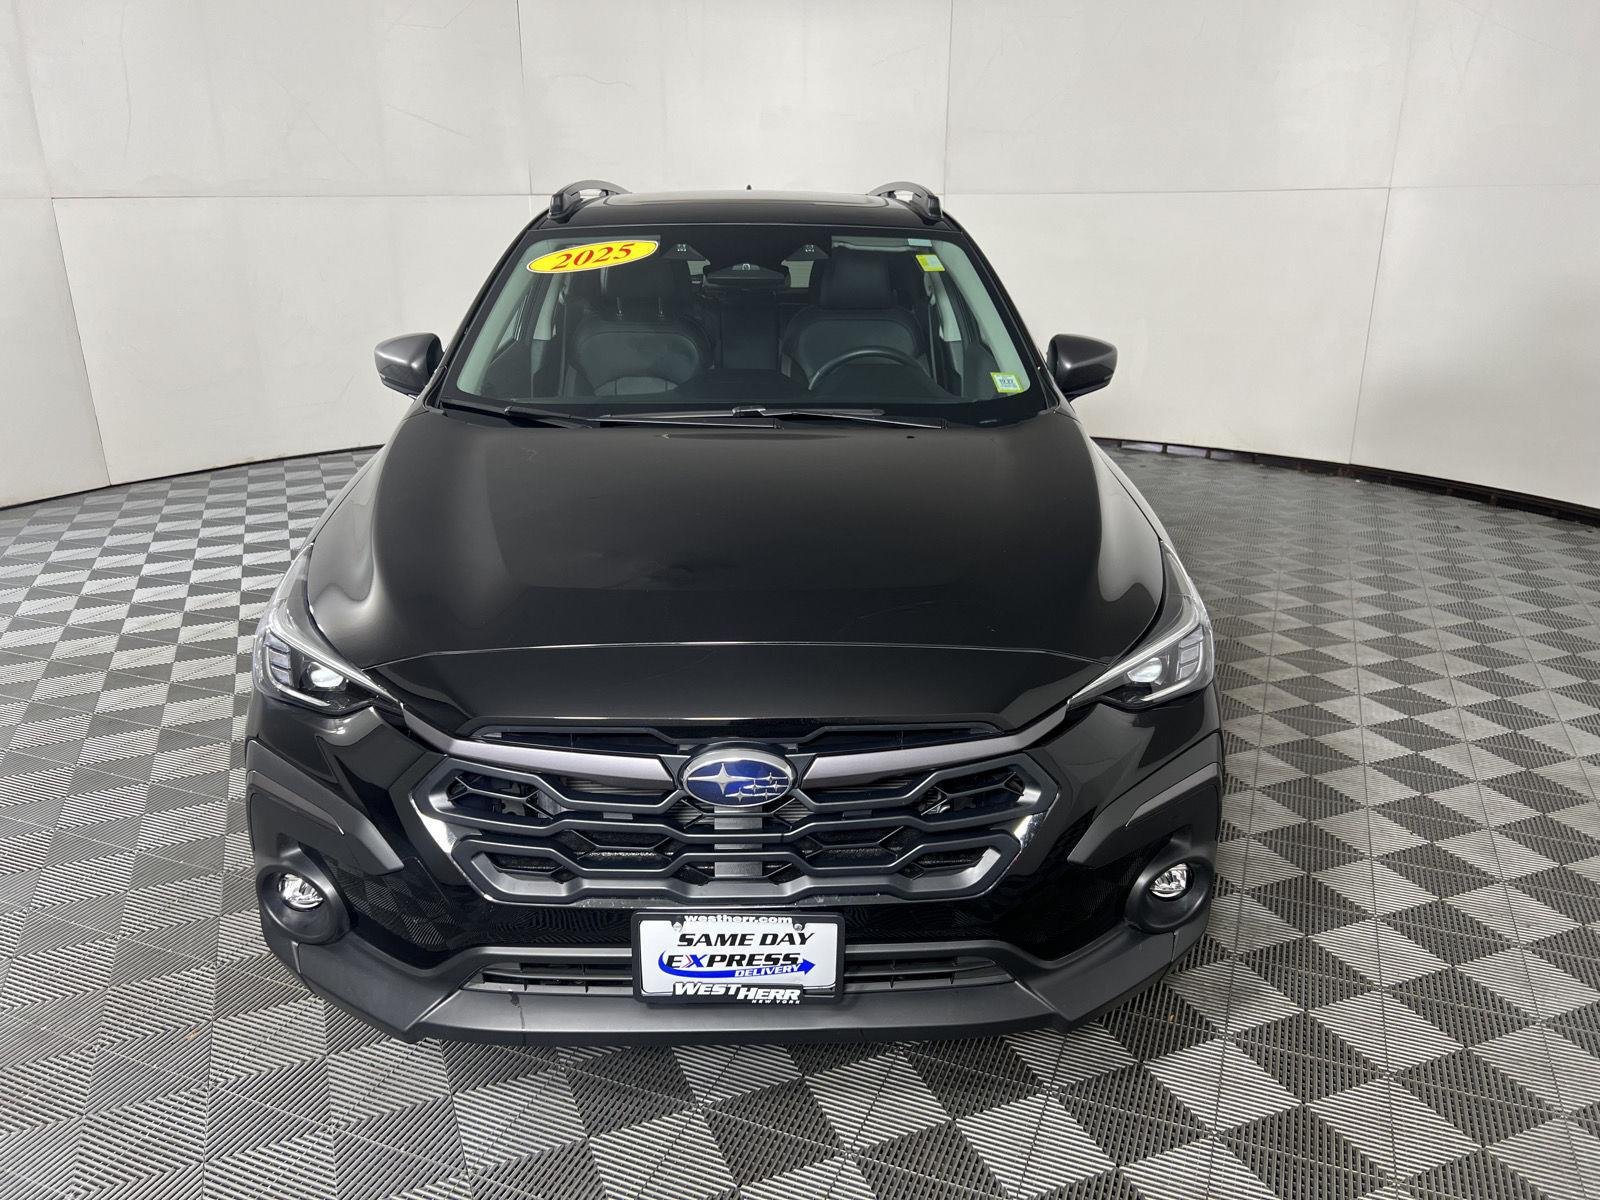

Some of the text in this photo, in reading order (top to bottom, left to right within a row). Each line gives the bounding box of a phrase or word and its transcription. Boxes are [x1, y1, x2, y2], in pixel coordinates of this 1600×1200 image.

[551, 243, 635, 270] 2025
[684, 914, 793, 924] westherr.com
[677, 932, 816, 947] SAME DAY
[665, 953, 801, 968] EXPRESS
[734, 963, 802, 978] DELIVERY
